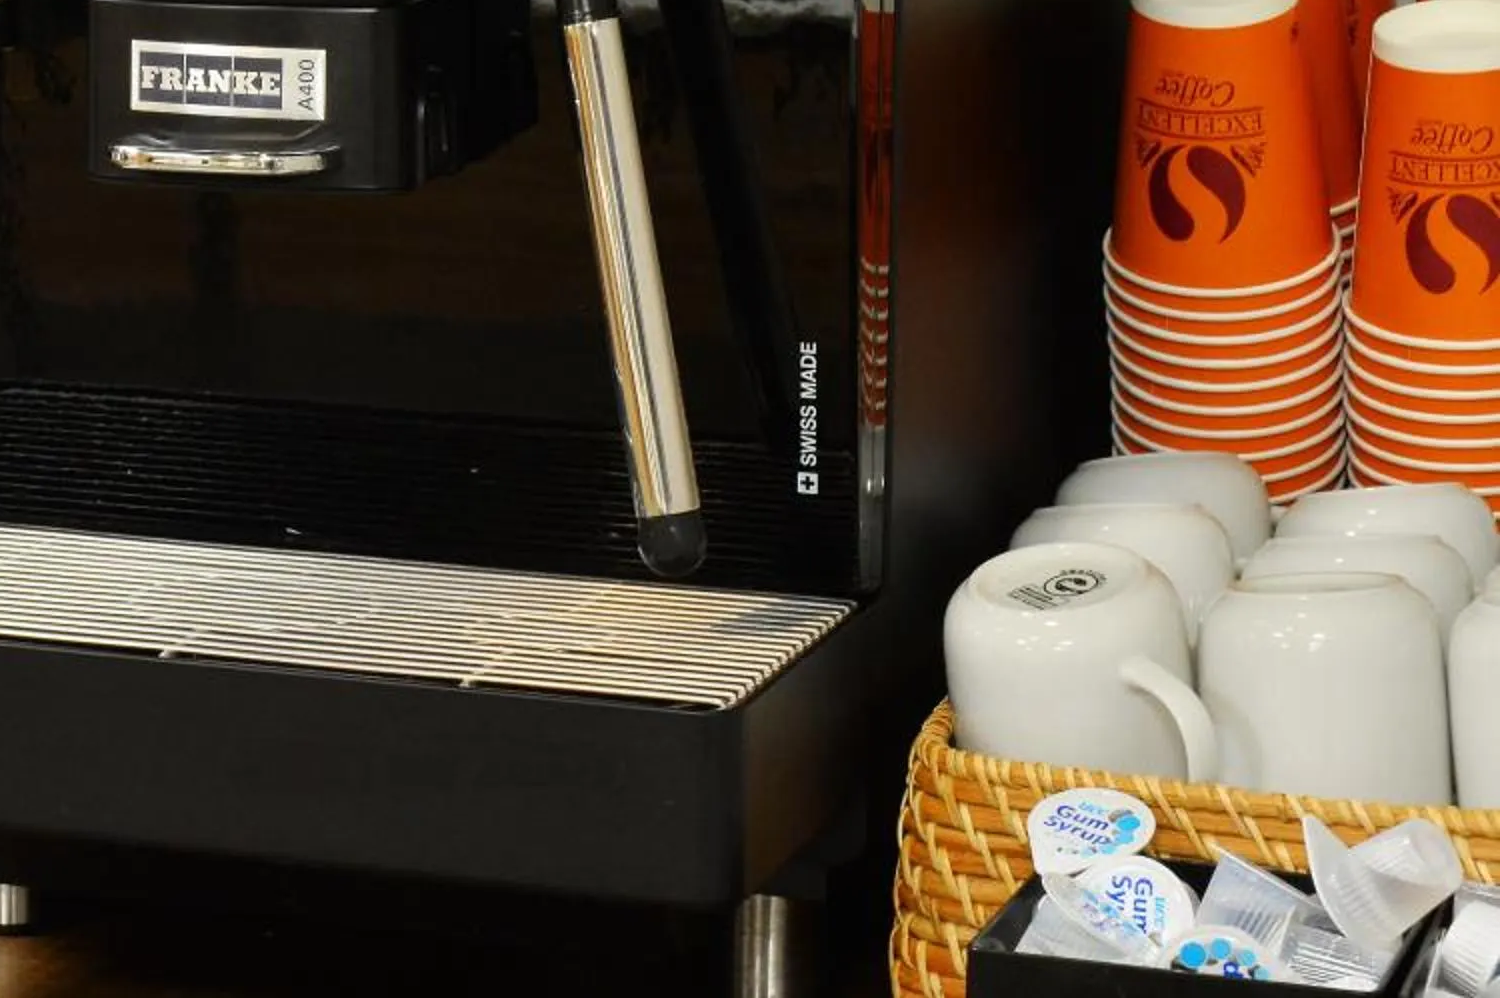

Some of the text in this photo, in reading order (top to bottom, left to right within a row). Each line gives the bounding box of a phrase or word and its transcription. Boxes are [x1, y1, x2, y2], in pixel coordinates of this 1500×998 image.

[141, 65, 281, 96] FRANKE
[297, 58, 315, 111] A400
[1155, 74, 1236, 108] Coffee
[1138, 104, 1263, 135] EXCELLENT
[1410, 122, 1494, 155] Coffee
[1389, 156, 1500, 183] XCELLENT
[799, 341, 818, 467] SWISS MADE
[1043, 814, 1114, 845] Syrup
[1056, 805, 1109, 831] Gum
